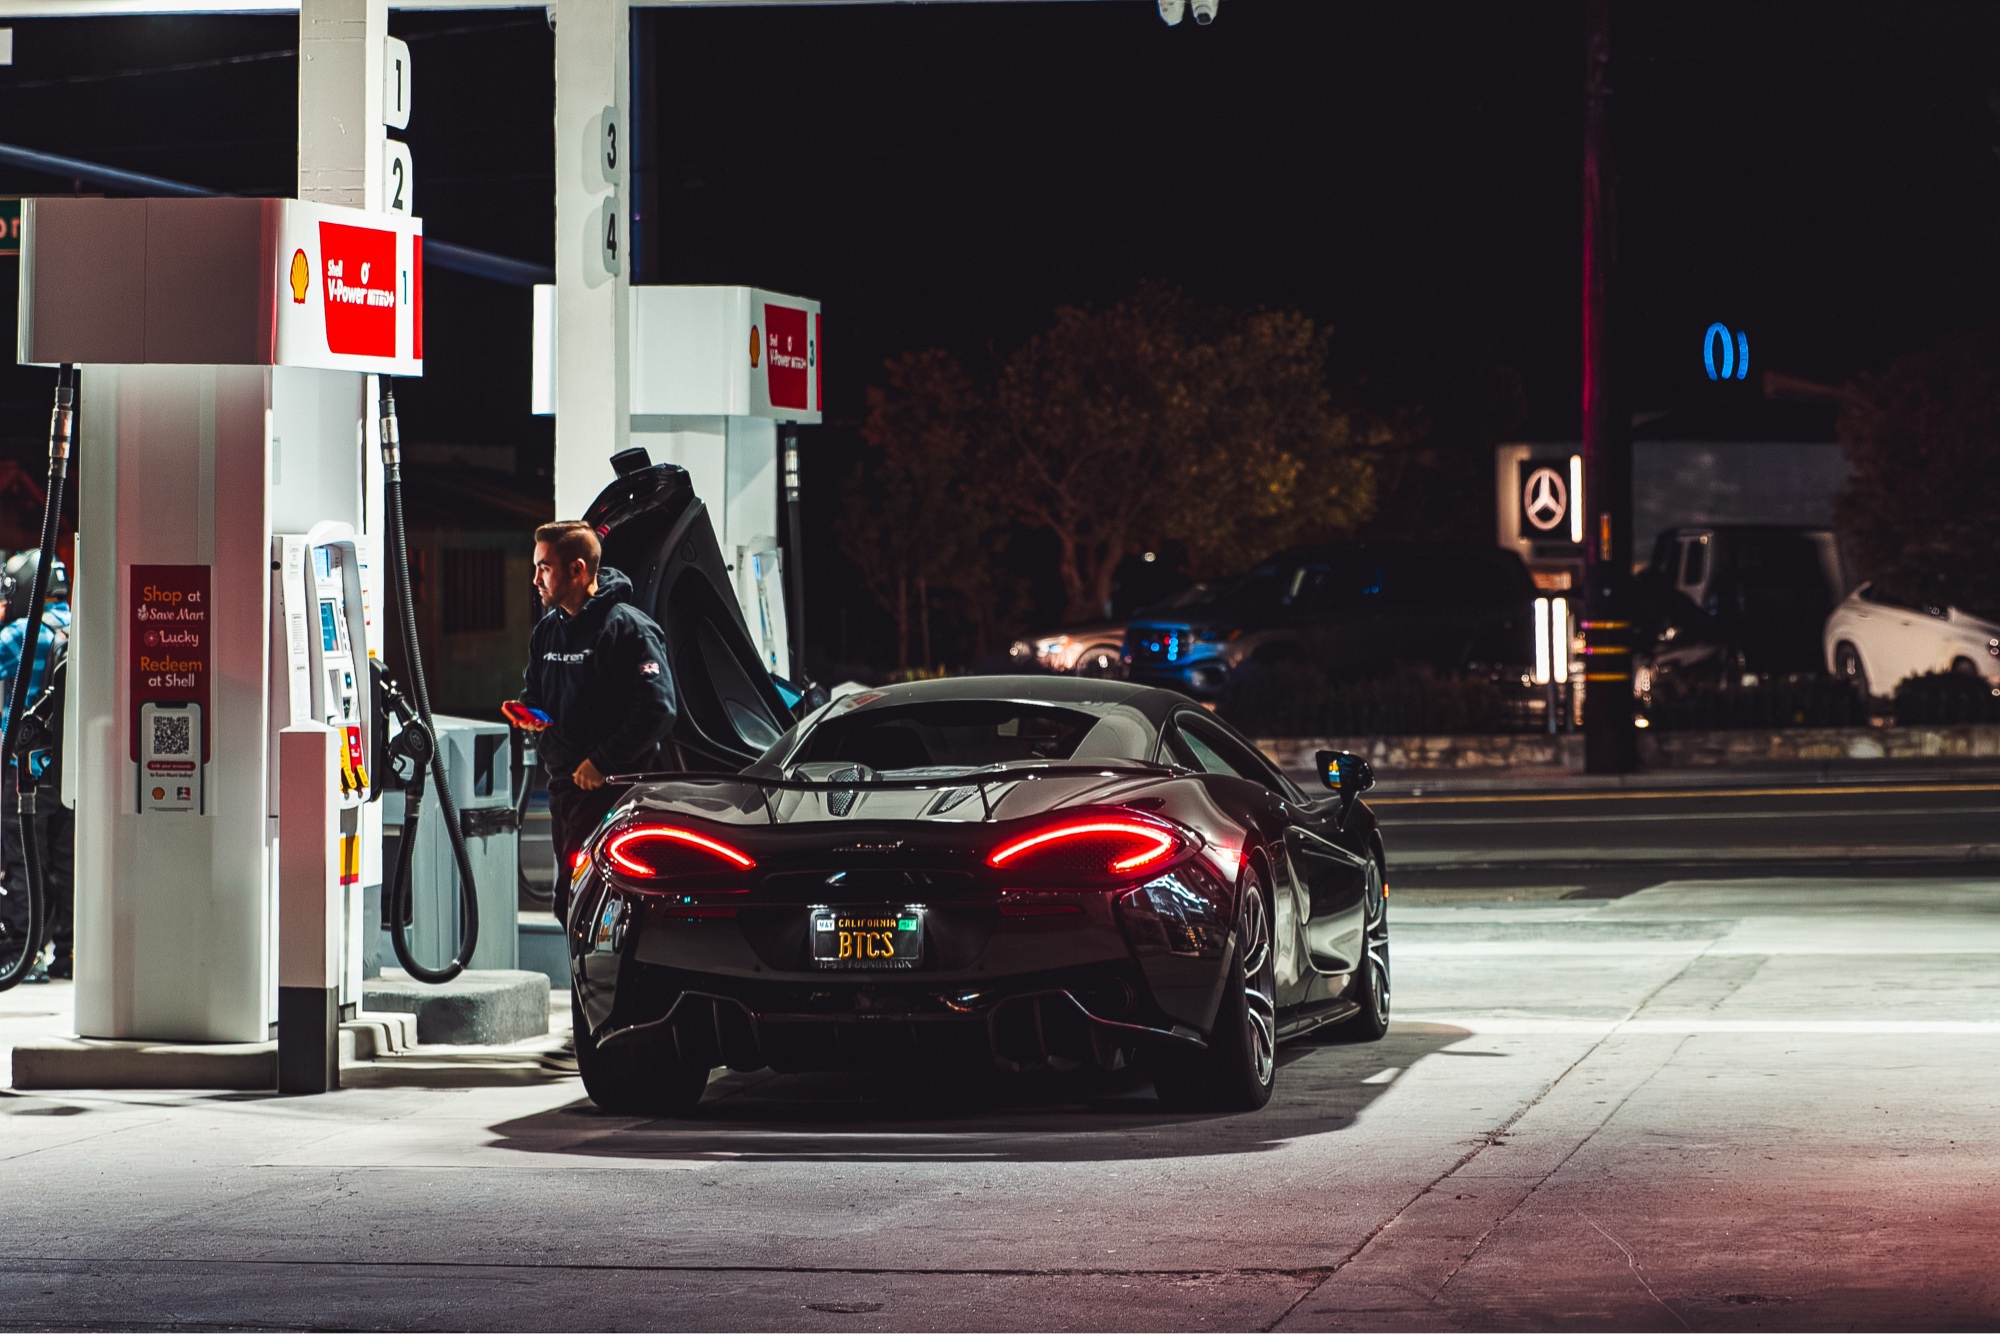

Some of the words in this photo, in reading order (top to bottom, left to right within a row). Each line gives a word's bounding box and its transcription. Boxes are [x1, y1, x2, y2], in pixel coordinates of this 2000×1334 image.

[395, 59, 402, 112] 1
[607, 122, 617, 170] 3
[392, 157, 404, 211] 2
[606, 212, 618, 261] 4
[327, 258, 343, 278] Shell
[327, 277, 367, 305] V-Power
[402, 270, 407, 305] 1
[143, 585, 183, 606] Shop
[187, 590, 201, 602] at
[149, 607, 175, 620] Save
[176, 607, 205, 620] Mart
[159, 629, 199, 647] Lucky
[140, 655, 202, 672] Redeem
[148, 675, 162, 687] at
[165, 673, 195, 687] Shell
[819, 920, 834, 929] MAY
[838, 918, 897, 928] CALIFORNIA
[838, 931, 895, 959] BTCS
